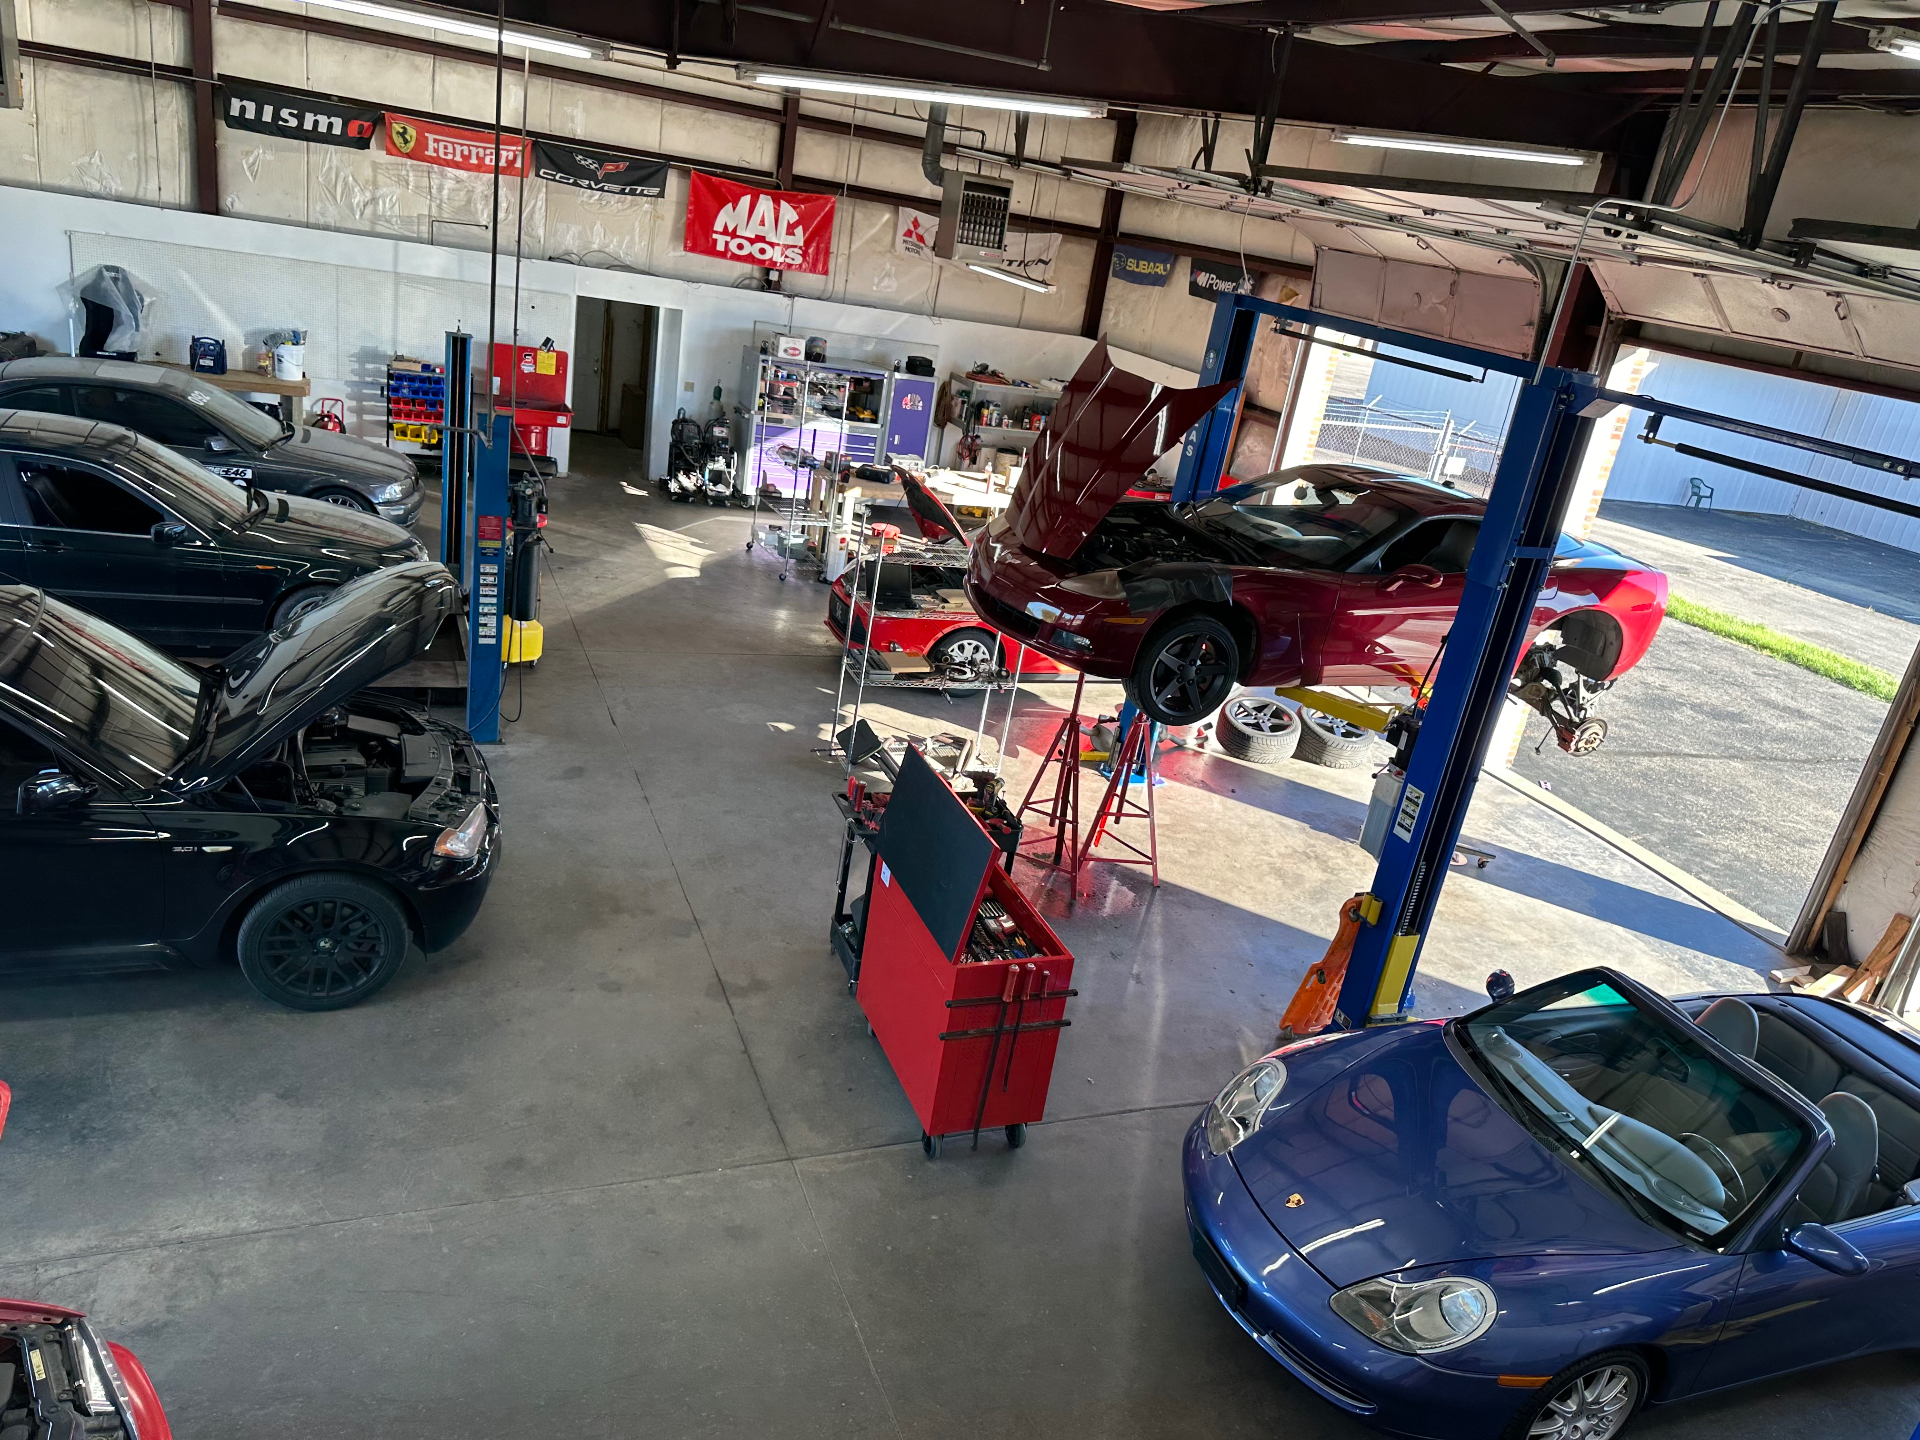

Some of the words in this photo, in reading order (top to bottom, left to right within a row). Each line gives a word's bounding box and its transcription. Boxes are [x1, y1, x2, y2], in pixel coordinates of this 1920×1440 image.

[229, 96, 373, 138] nismo
[424, 132, 523, 168] Ferrari
[539, 168, 661, 196] CORVETTE
[713, 193, 804, 247] MAC
[711, 233, 804, 265] TOOLS
[1126, 258, 1170, 275] SUBARU
